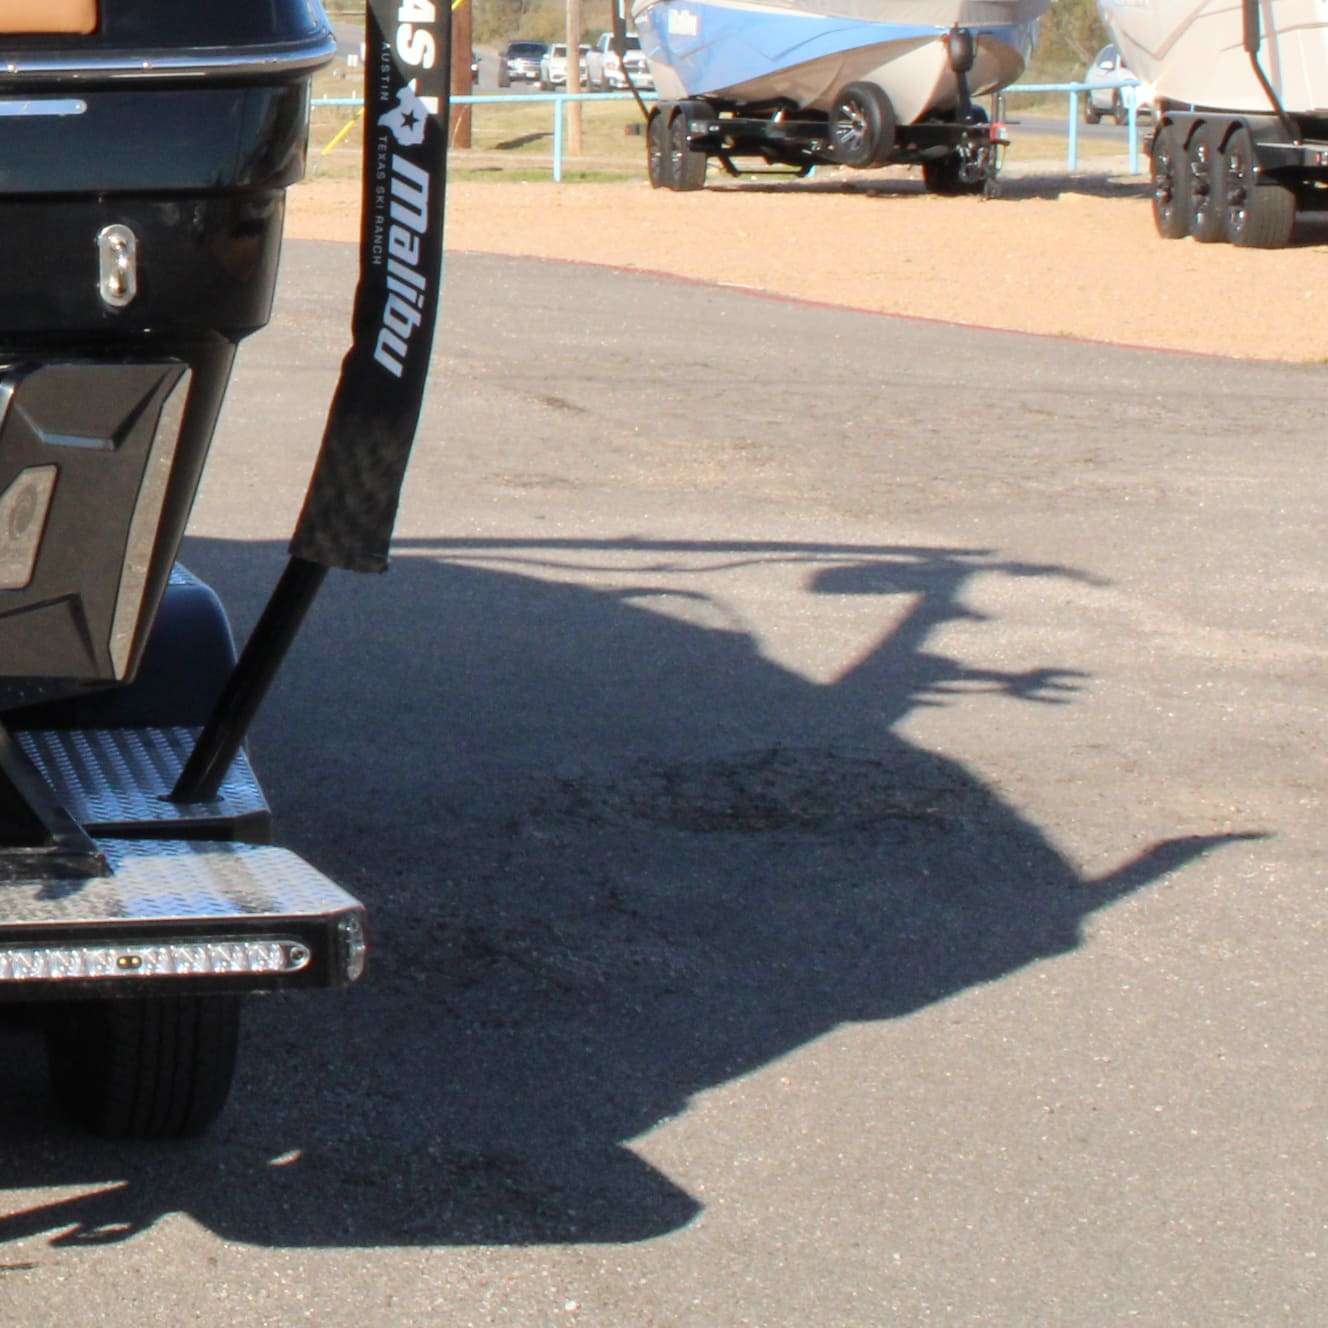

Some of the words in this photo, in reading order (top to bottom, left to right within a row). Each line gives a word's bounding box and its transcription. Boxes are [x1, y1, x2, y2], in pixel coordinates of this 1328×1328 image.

[380, 41, 392, 101] AUSTIN
[375, 135, 388, 184] TEXAS
[374, 187, 386, 210] SKI
[372, 215, 385, 266] RANCH
